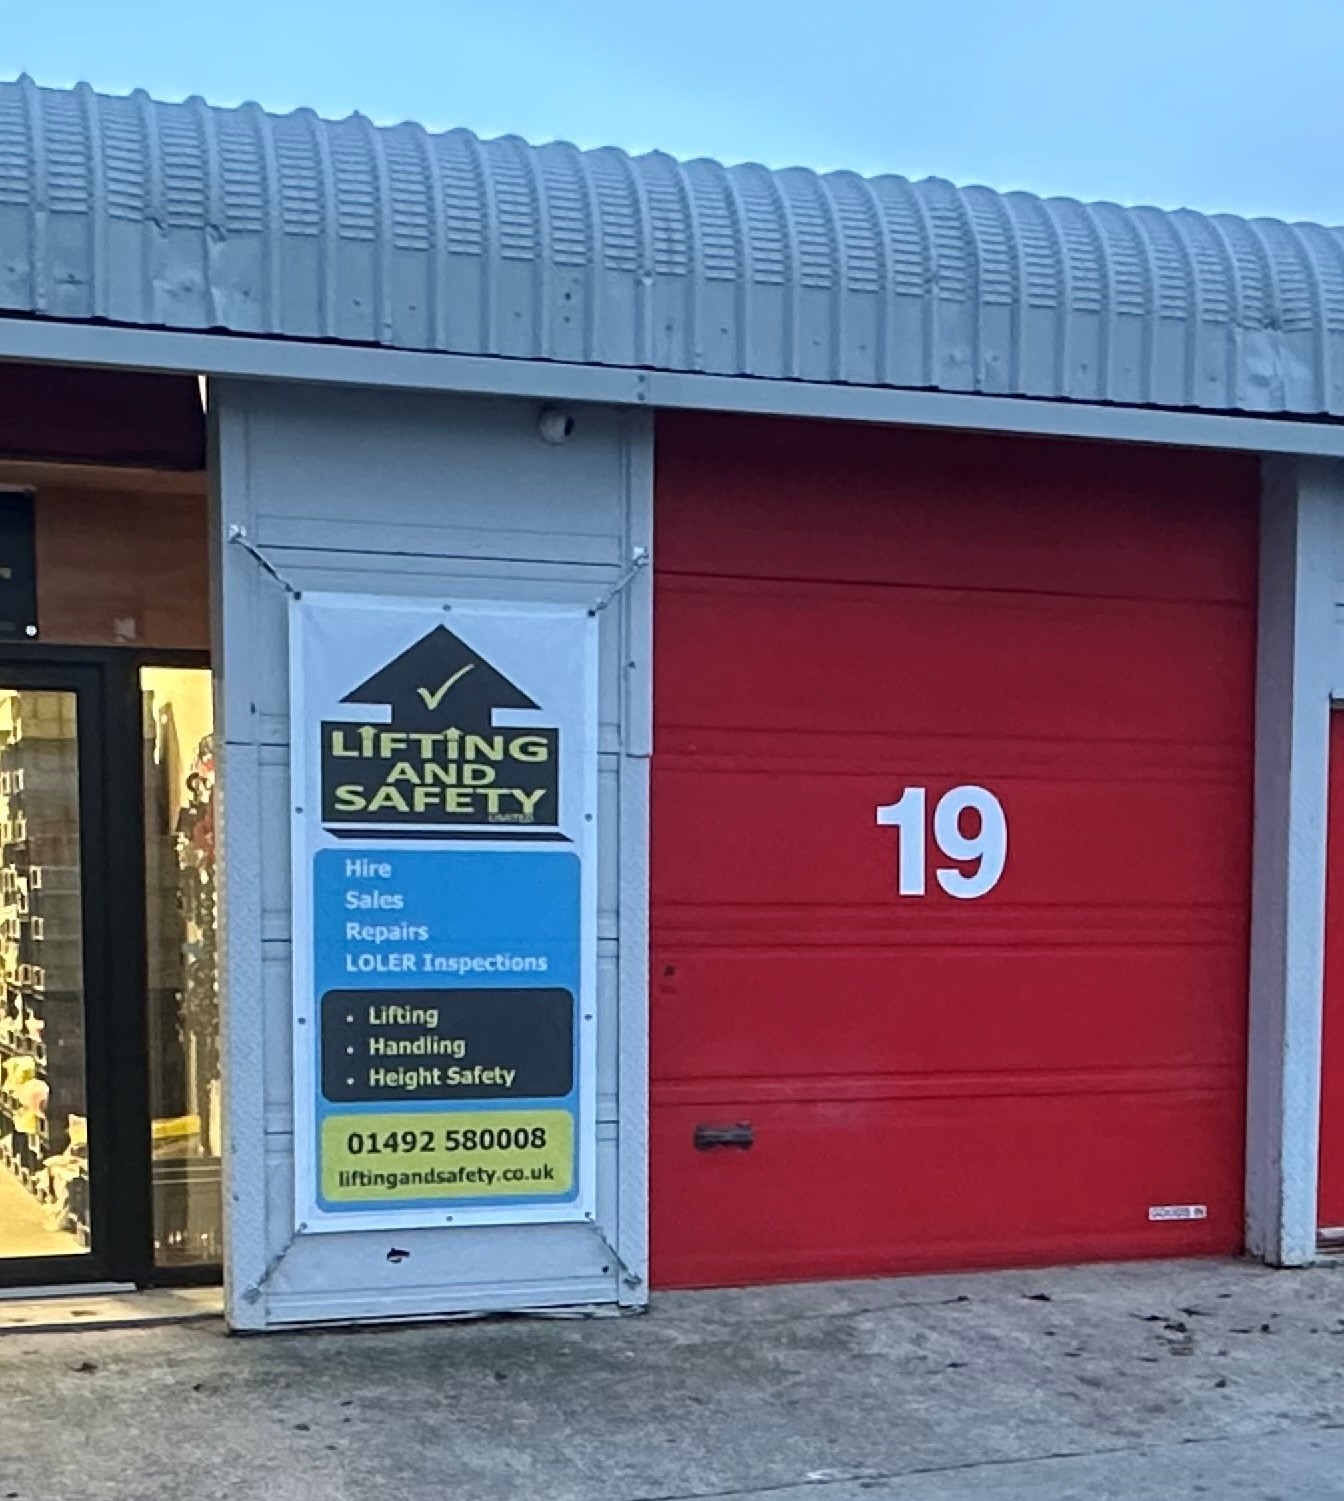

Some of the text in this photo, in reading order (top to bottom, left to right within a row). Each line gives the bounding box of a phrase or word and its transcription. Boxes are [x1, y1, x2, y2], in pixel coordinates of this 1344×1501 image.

[331, 725, 549, 763] LIFTING
[386, 761, 496, 786] AND
[334, 785, 547, 815] SAFETY
[876, 784, 1008, 899] 19
[345, 859, 392, 879] Hire
[345, 891, 404, 910] Sales
[346, 922, 430, 945] Repairs
[346, 952, 549, 976] LOLER Inspections
[368, 1005, 440, 1028] Lifting
[369, 1036, 467, 1059] Handling
[369, 1065, 516, 1091] Height Safety
[347, 1127, 547, 1155] 01492 580008
[338, 1163, 555, 1190] liftingandsafety.co.uk
